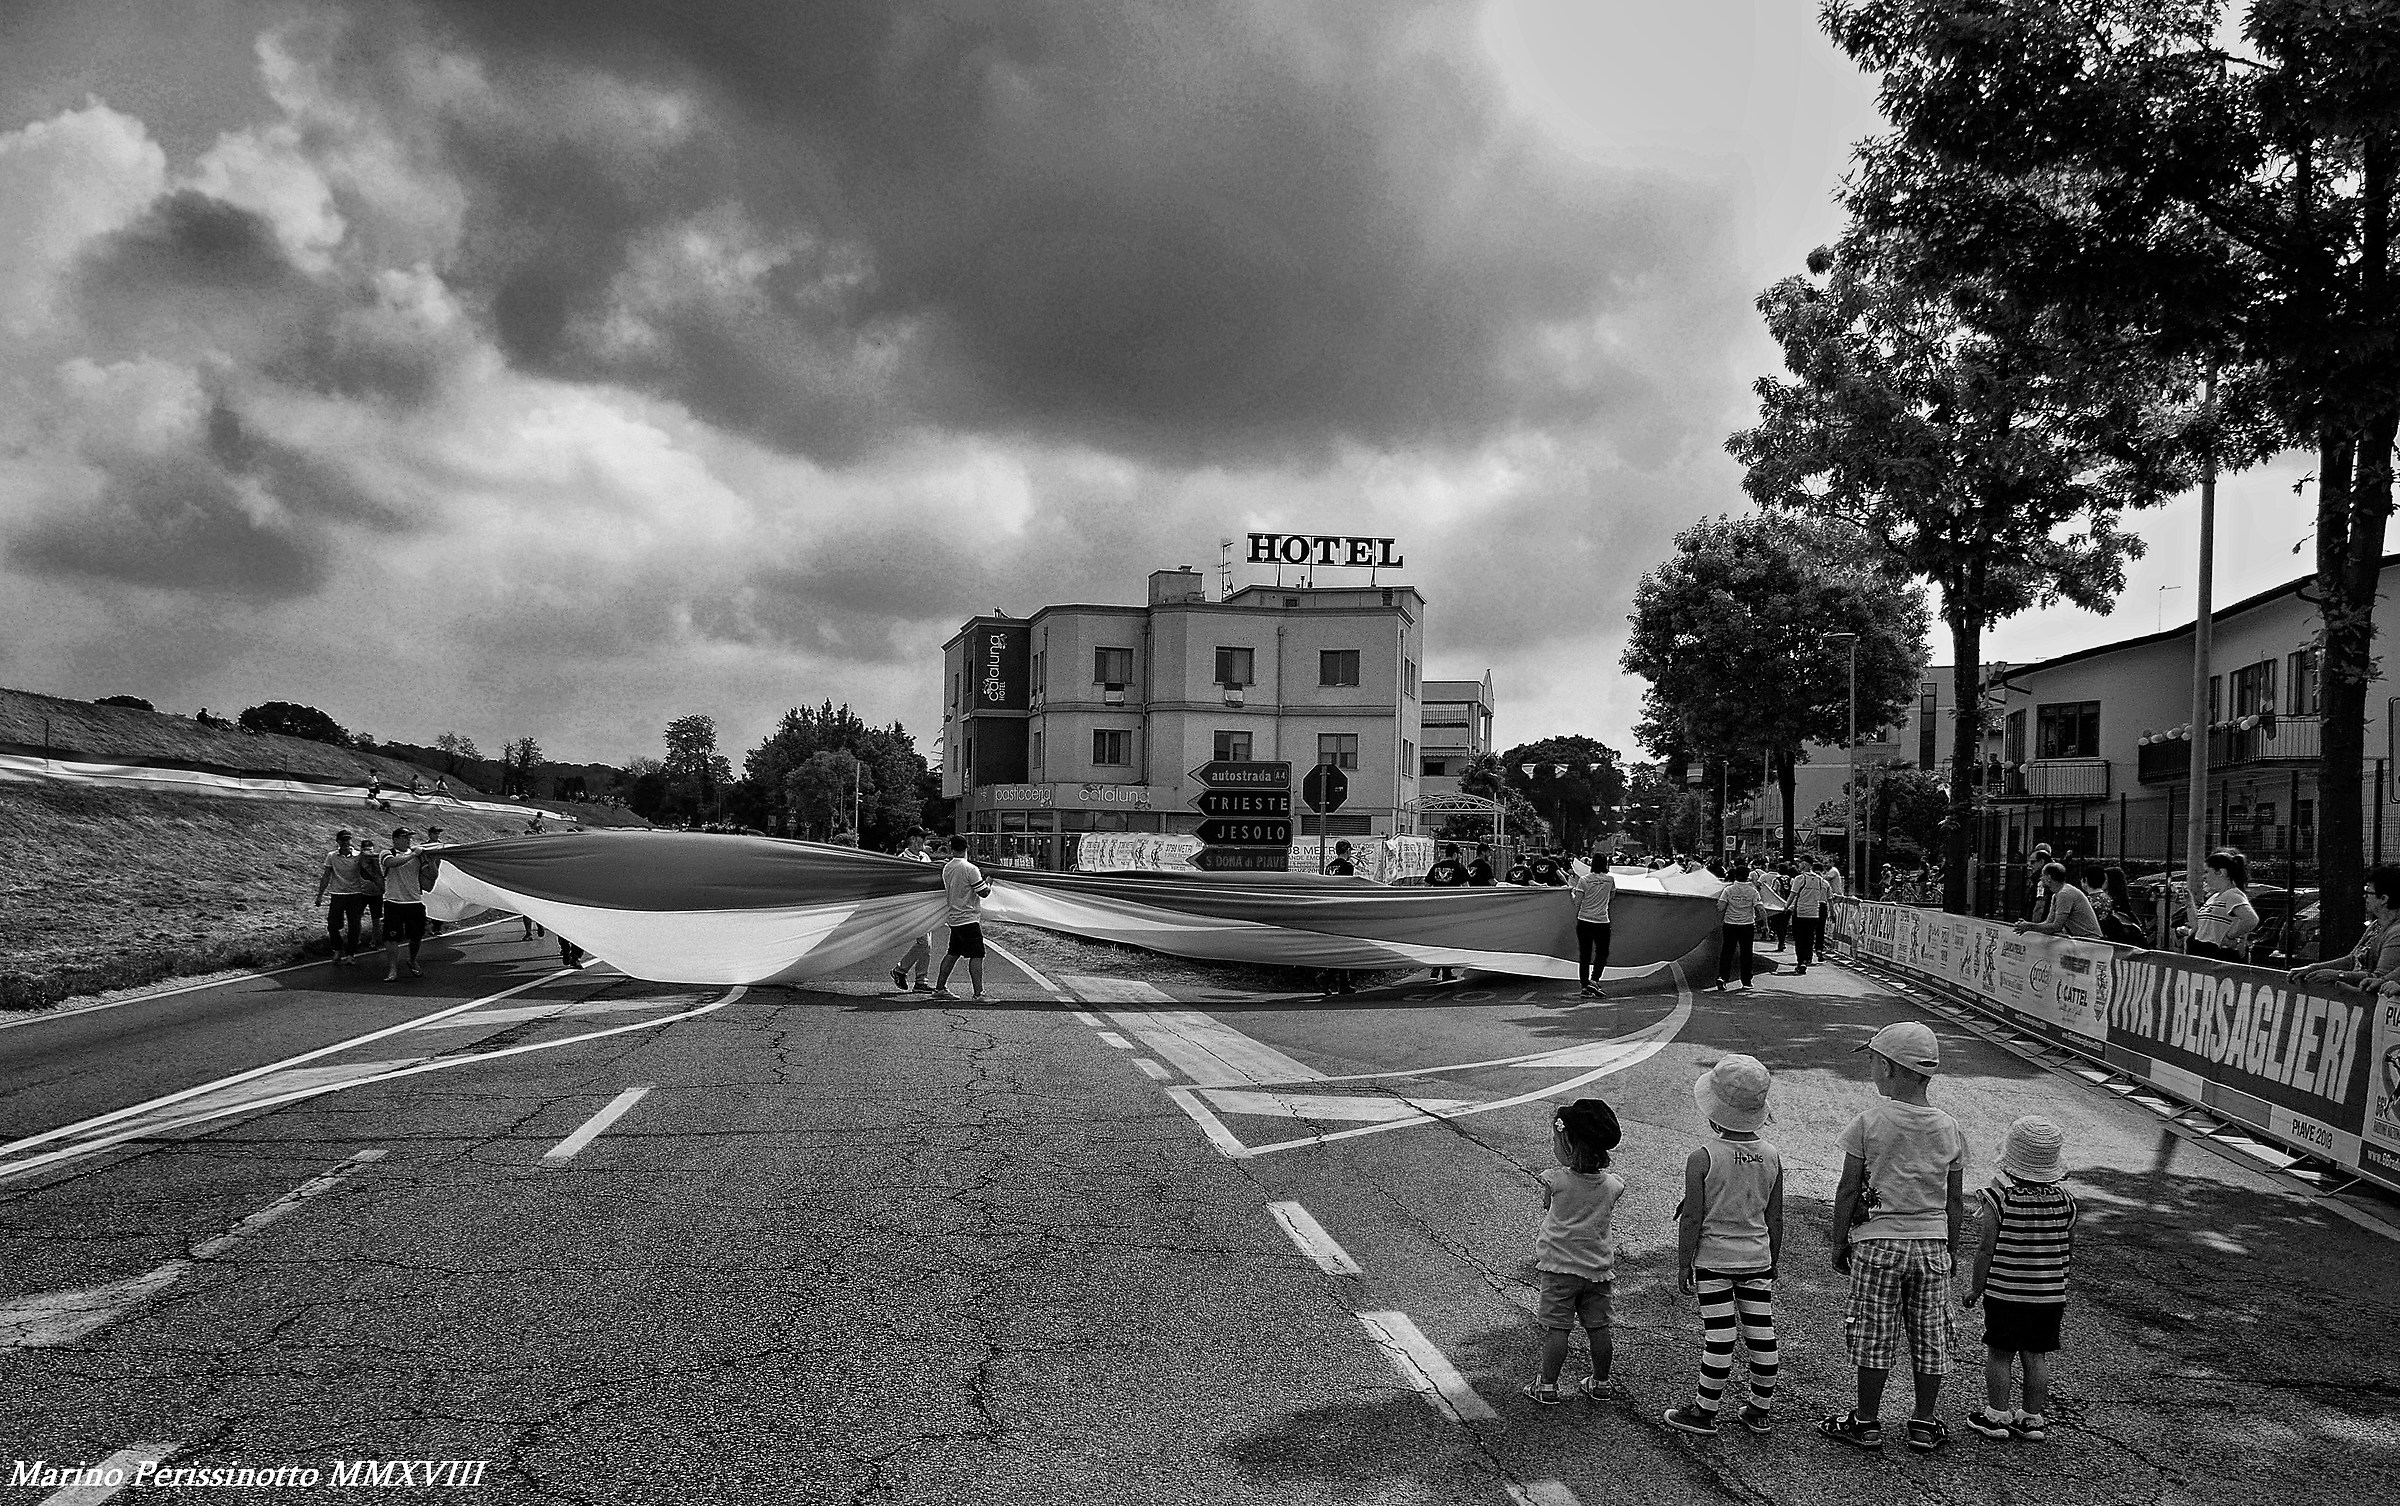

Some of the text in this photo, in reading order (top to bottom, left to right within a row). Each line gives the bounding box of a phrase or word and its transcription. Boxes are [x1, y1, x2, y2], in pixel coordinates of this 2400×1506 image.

[1247, 533, 1403, 568] HOTEL
[1211, 769, 1272, 782] autostrada
[995, 786, 1051, 803] pasticceria
[1209, 797, 1288, 811] TRIESTE
[1217, 825, 1285, 840] JESOLO
[1256, 855, 1286, 869] PIAVE
[2063, 984, 2088, 1008] CATTEL
[2112, 958, 2157, 1038] VIVA
[2157, 967, 2172, 1042] I
[2169, 970, 2364, 1105] BERSAGLIERI
[2291, 1118, 2316, 1142] PIAVE
